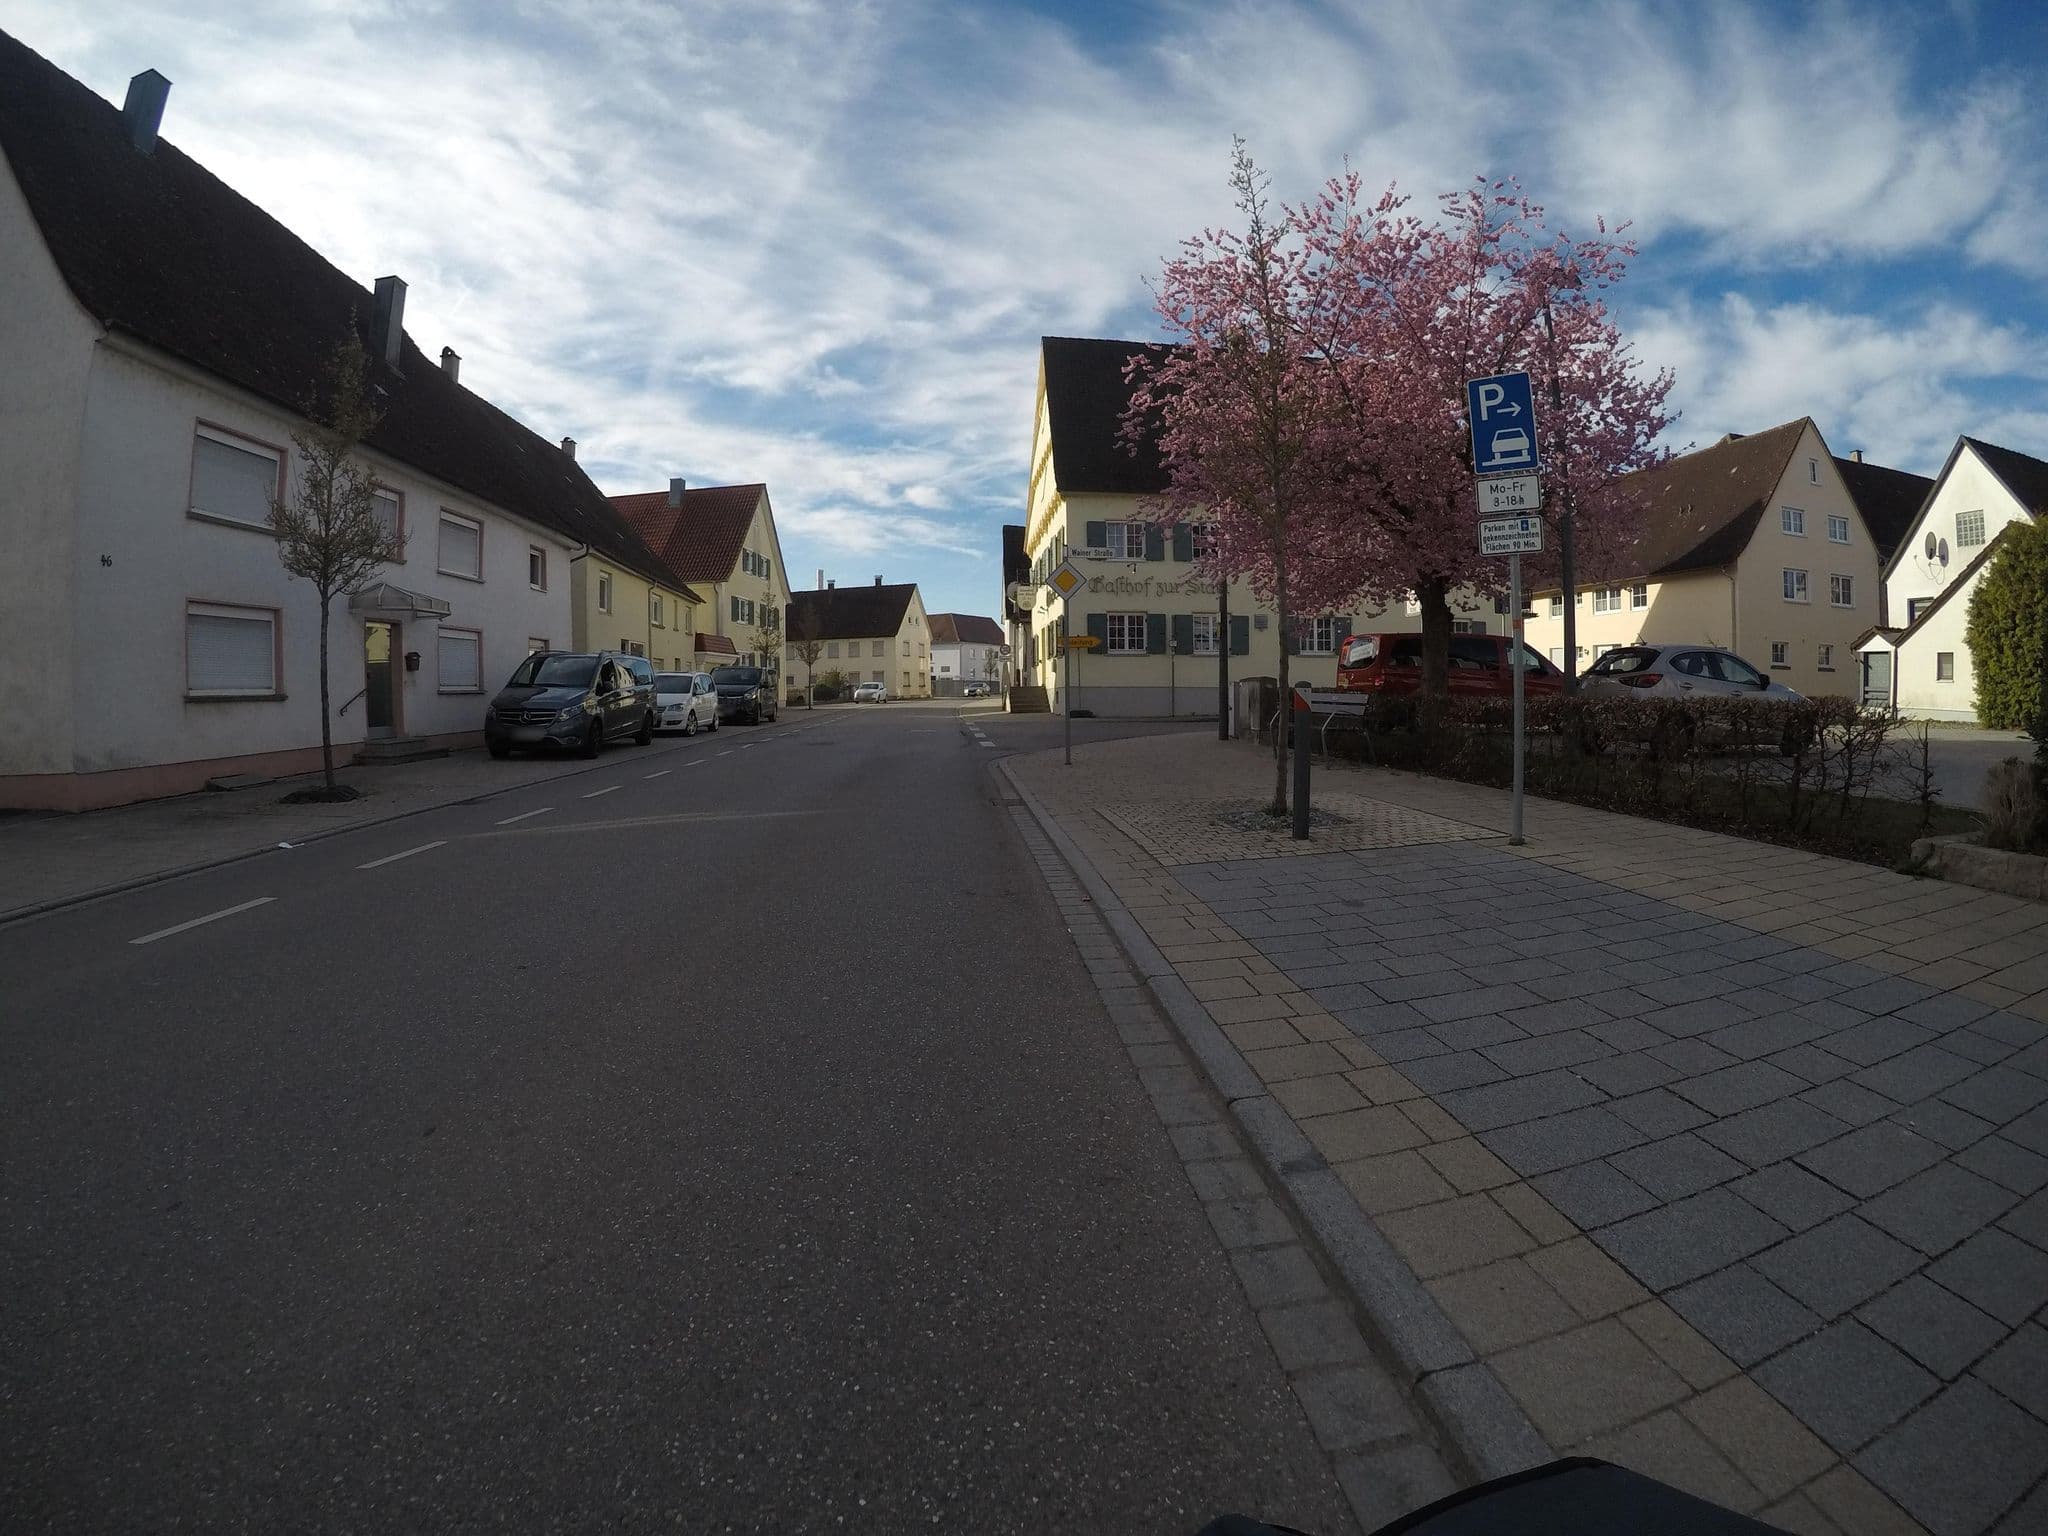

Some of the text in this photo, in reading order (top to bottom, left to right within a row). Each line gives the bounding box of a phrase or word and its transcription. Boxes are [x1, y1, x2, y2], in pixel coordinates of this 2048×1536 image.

[1479, 383, 1504, 421] P
[1490, 482, 1525, 494] Mo-Fr
[1484, 520, 1537, 532] Parken mit in
[1483, 530, 1540, 544] gekennzeichneten
[1486, 542, 1511, 552] Flächen
[1513, 541, 1520, 550] 90
